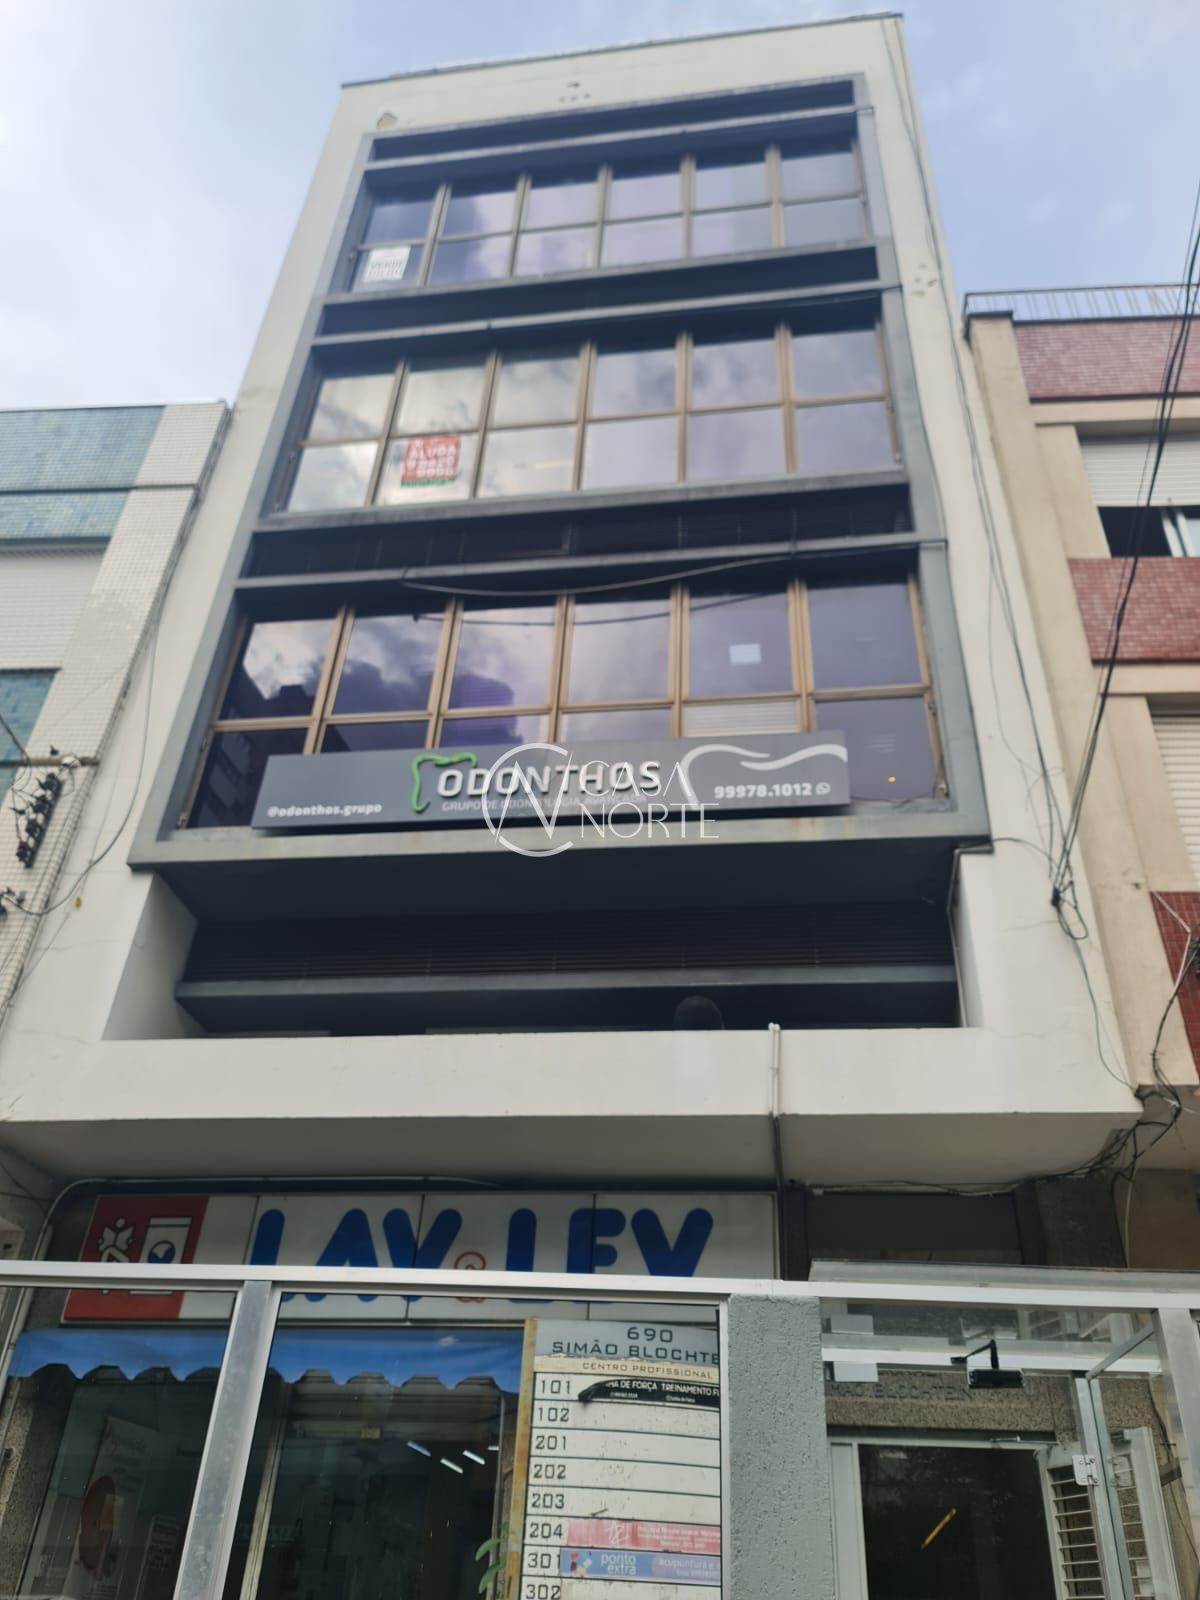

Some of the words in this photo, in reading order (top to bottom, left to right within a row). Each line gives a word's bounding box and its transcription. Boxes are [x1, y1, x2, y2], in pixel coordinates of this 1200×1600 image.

[437, 760, 661, 798] ODONTHOS
[714, 783, 812, 800] 99978.1012
[267, 804, 382, 818] @odonthos.grupo
[627, 1326, 673, 1343] 690
[551, 1339, 618, 1356] SIMÃO
[582, 1362, 628, 1372] CENTRO
[632, 1364, 713, 1379] PROFISSIONAL
[540, 1379, 571, 1395] 101
[620, 1380, 630, 1389] DE
[632, 1380, 658, 1392] FORÇA
[661, 1383, 712, 1396] TREINAMENTO
[538, 1407, 570, 1423] 102
[535, 1435, 567, 1451] 201
[533, 1463, 567, 1480] 202
[531, 1492, 565, 1509] 203
[529, 1522, 563, 1539] 204
[527, 1553, 560, 1569] 301
[601, 1554, 636, 1567] ponto
[607, 1565, 636, 1576] extra
[525, 1584, 561, 1600] 302
